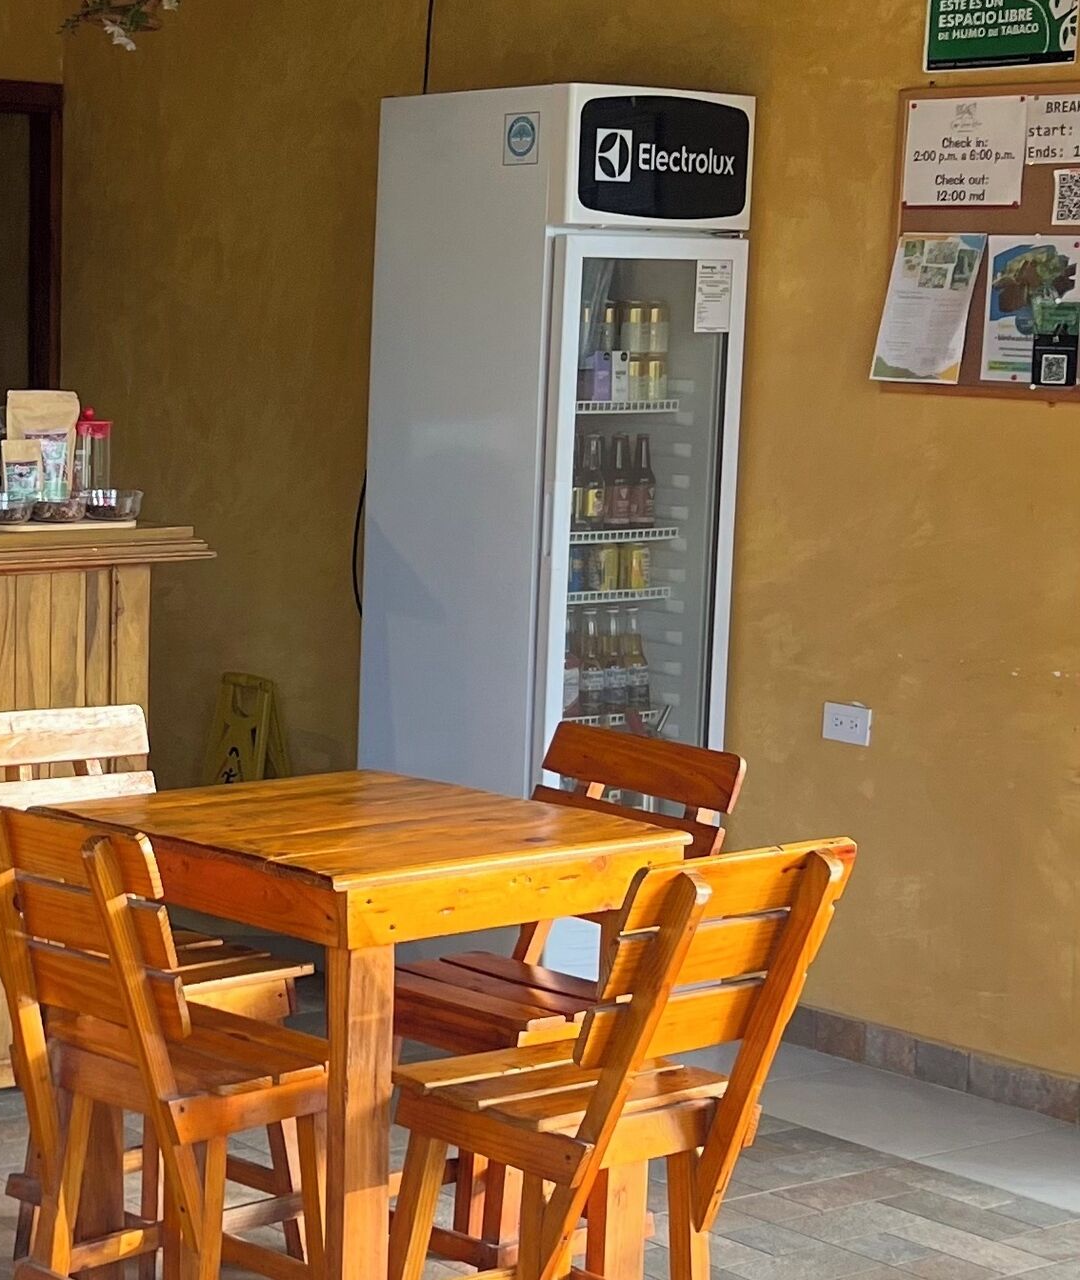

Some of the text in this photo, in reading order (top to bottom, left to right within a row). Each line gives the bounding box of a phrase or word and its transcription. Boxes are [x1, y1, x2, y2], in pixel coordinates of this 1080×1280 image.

[938, 7, 1033, 28] ESPACIO LIBRE
[952, 27, 986, 39] HUMO
[1001, 23, 1039, 35] TABACO
[1027, 123, 1073, 137] start:
[941, 136, 989, 148] Check in:
[913, 150, 937, 162] 2:00
[1027, 145, 1063, 158] Ends:
[638, 142, 735, 176] Electrolux
[935, 173, 989, 186] Check out:
[936, 190, 986, 201] 12:00 md
